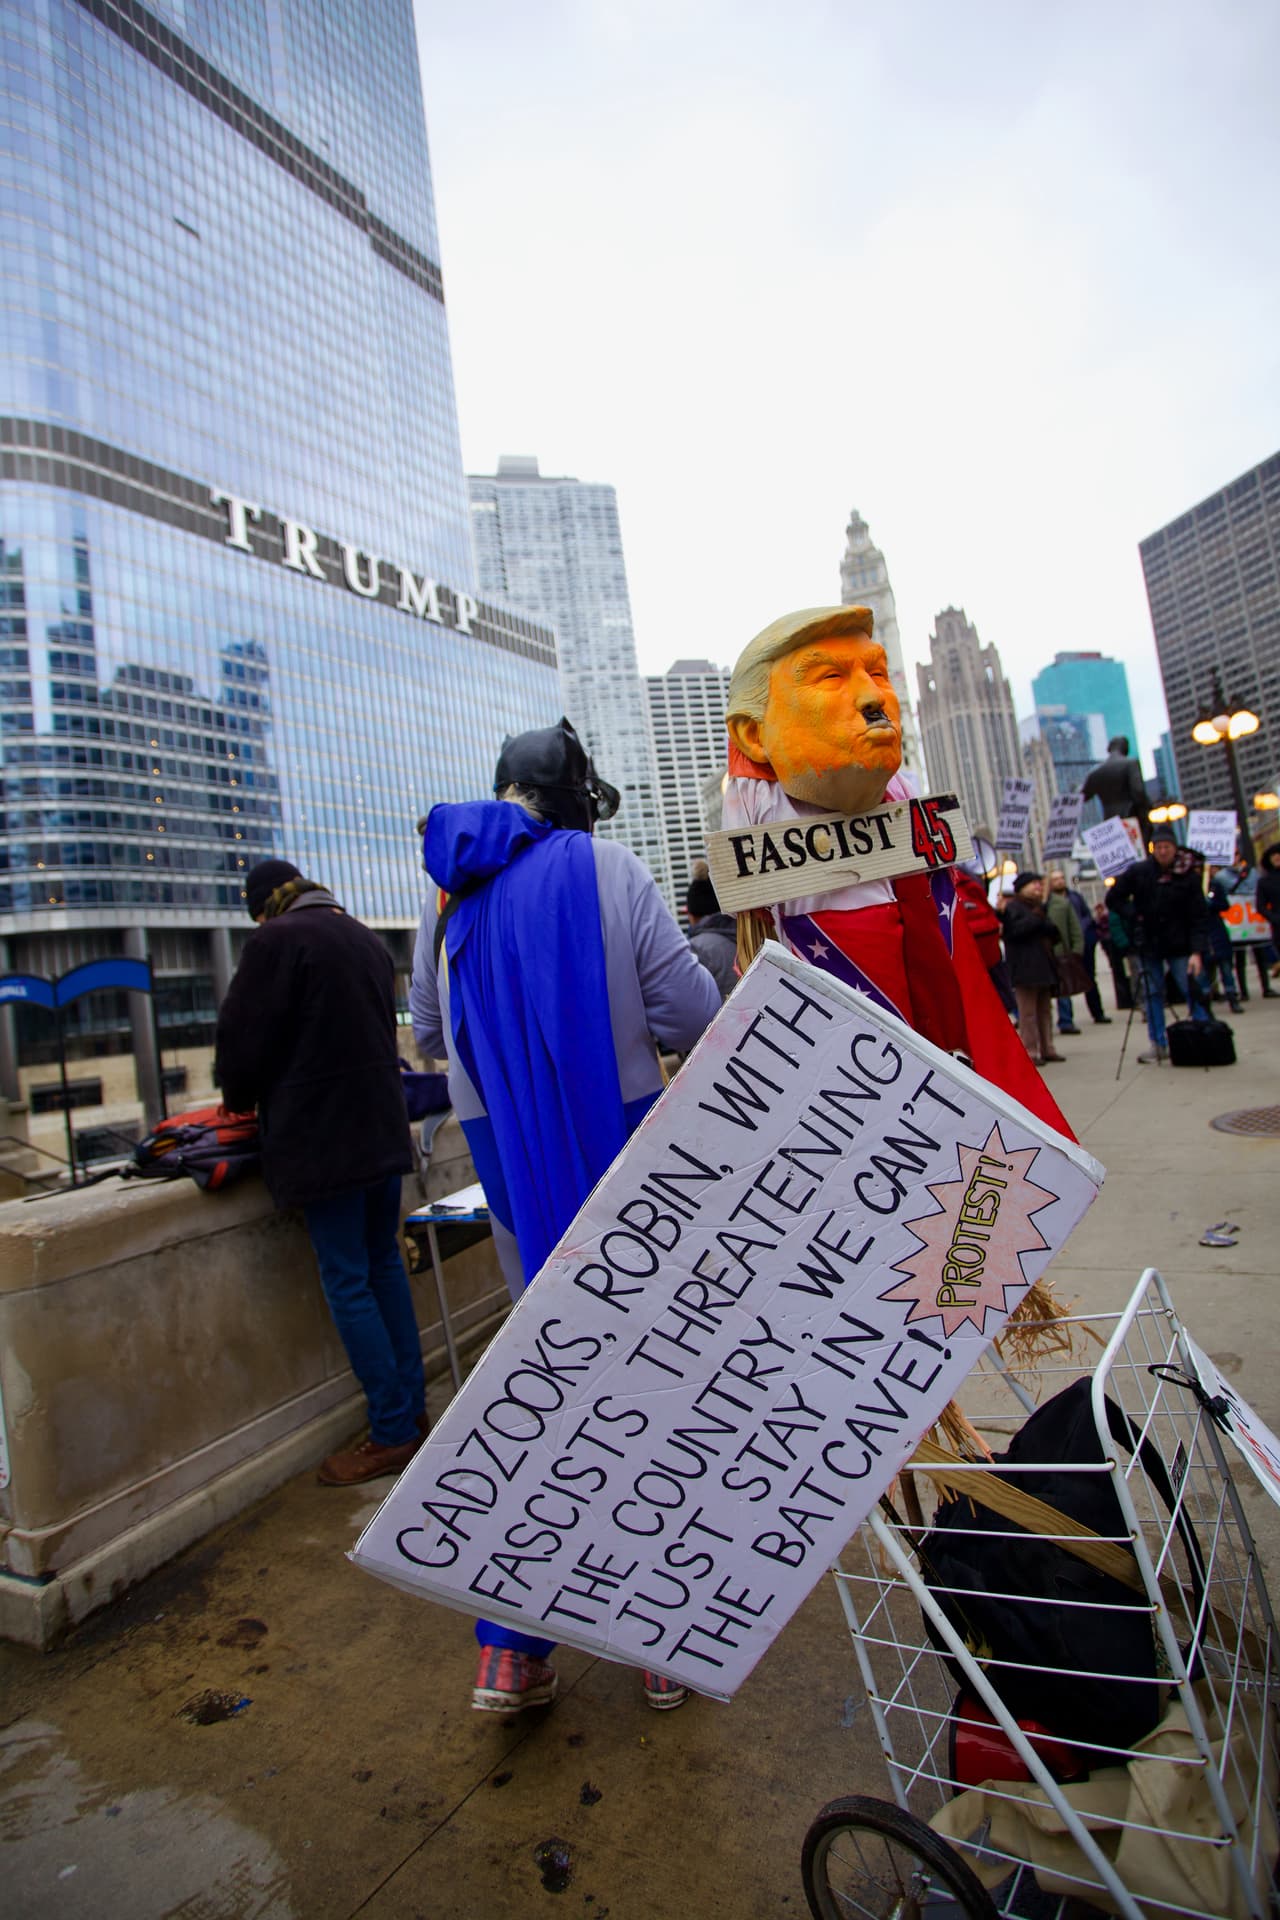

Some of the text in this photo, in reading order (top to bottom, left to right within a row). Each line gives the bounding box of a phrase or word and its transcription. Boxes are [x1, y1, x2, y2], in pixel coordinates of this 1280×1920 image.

[210, 487, 478, 635] TRUMP
[728, 796, 960, 878] FASCIST 45
[1198, 815, 1227, 825] STOP
[397, 978, 833, 1568] GADZOOKS, ROBIN, WITH
[936, 1154, 1014, 1308] PROTEST!
[469, 1033, 903, 1608] FASCISTS THREATENING
[541, 1070, 966, 1625] THE COUNTRY, WE CAN'T
[616, 1312, 884, 1647] JUST STAY IN
[666, 1576, 775, 1668] THE
